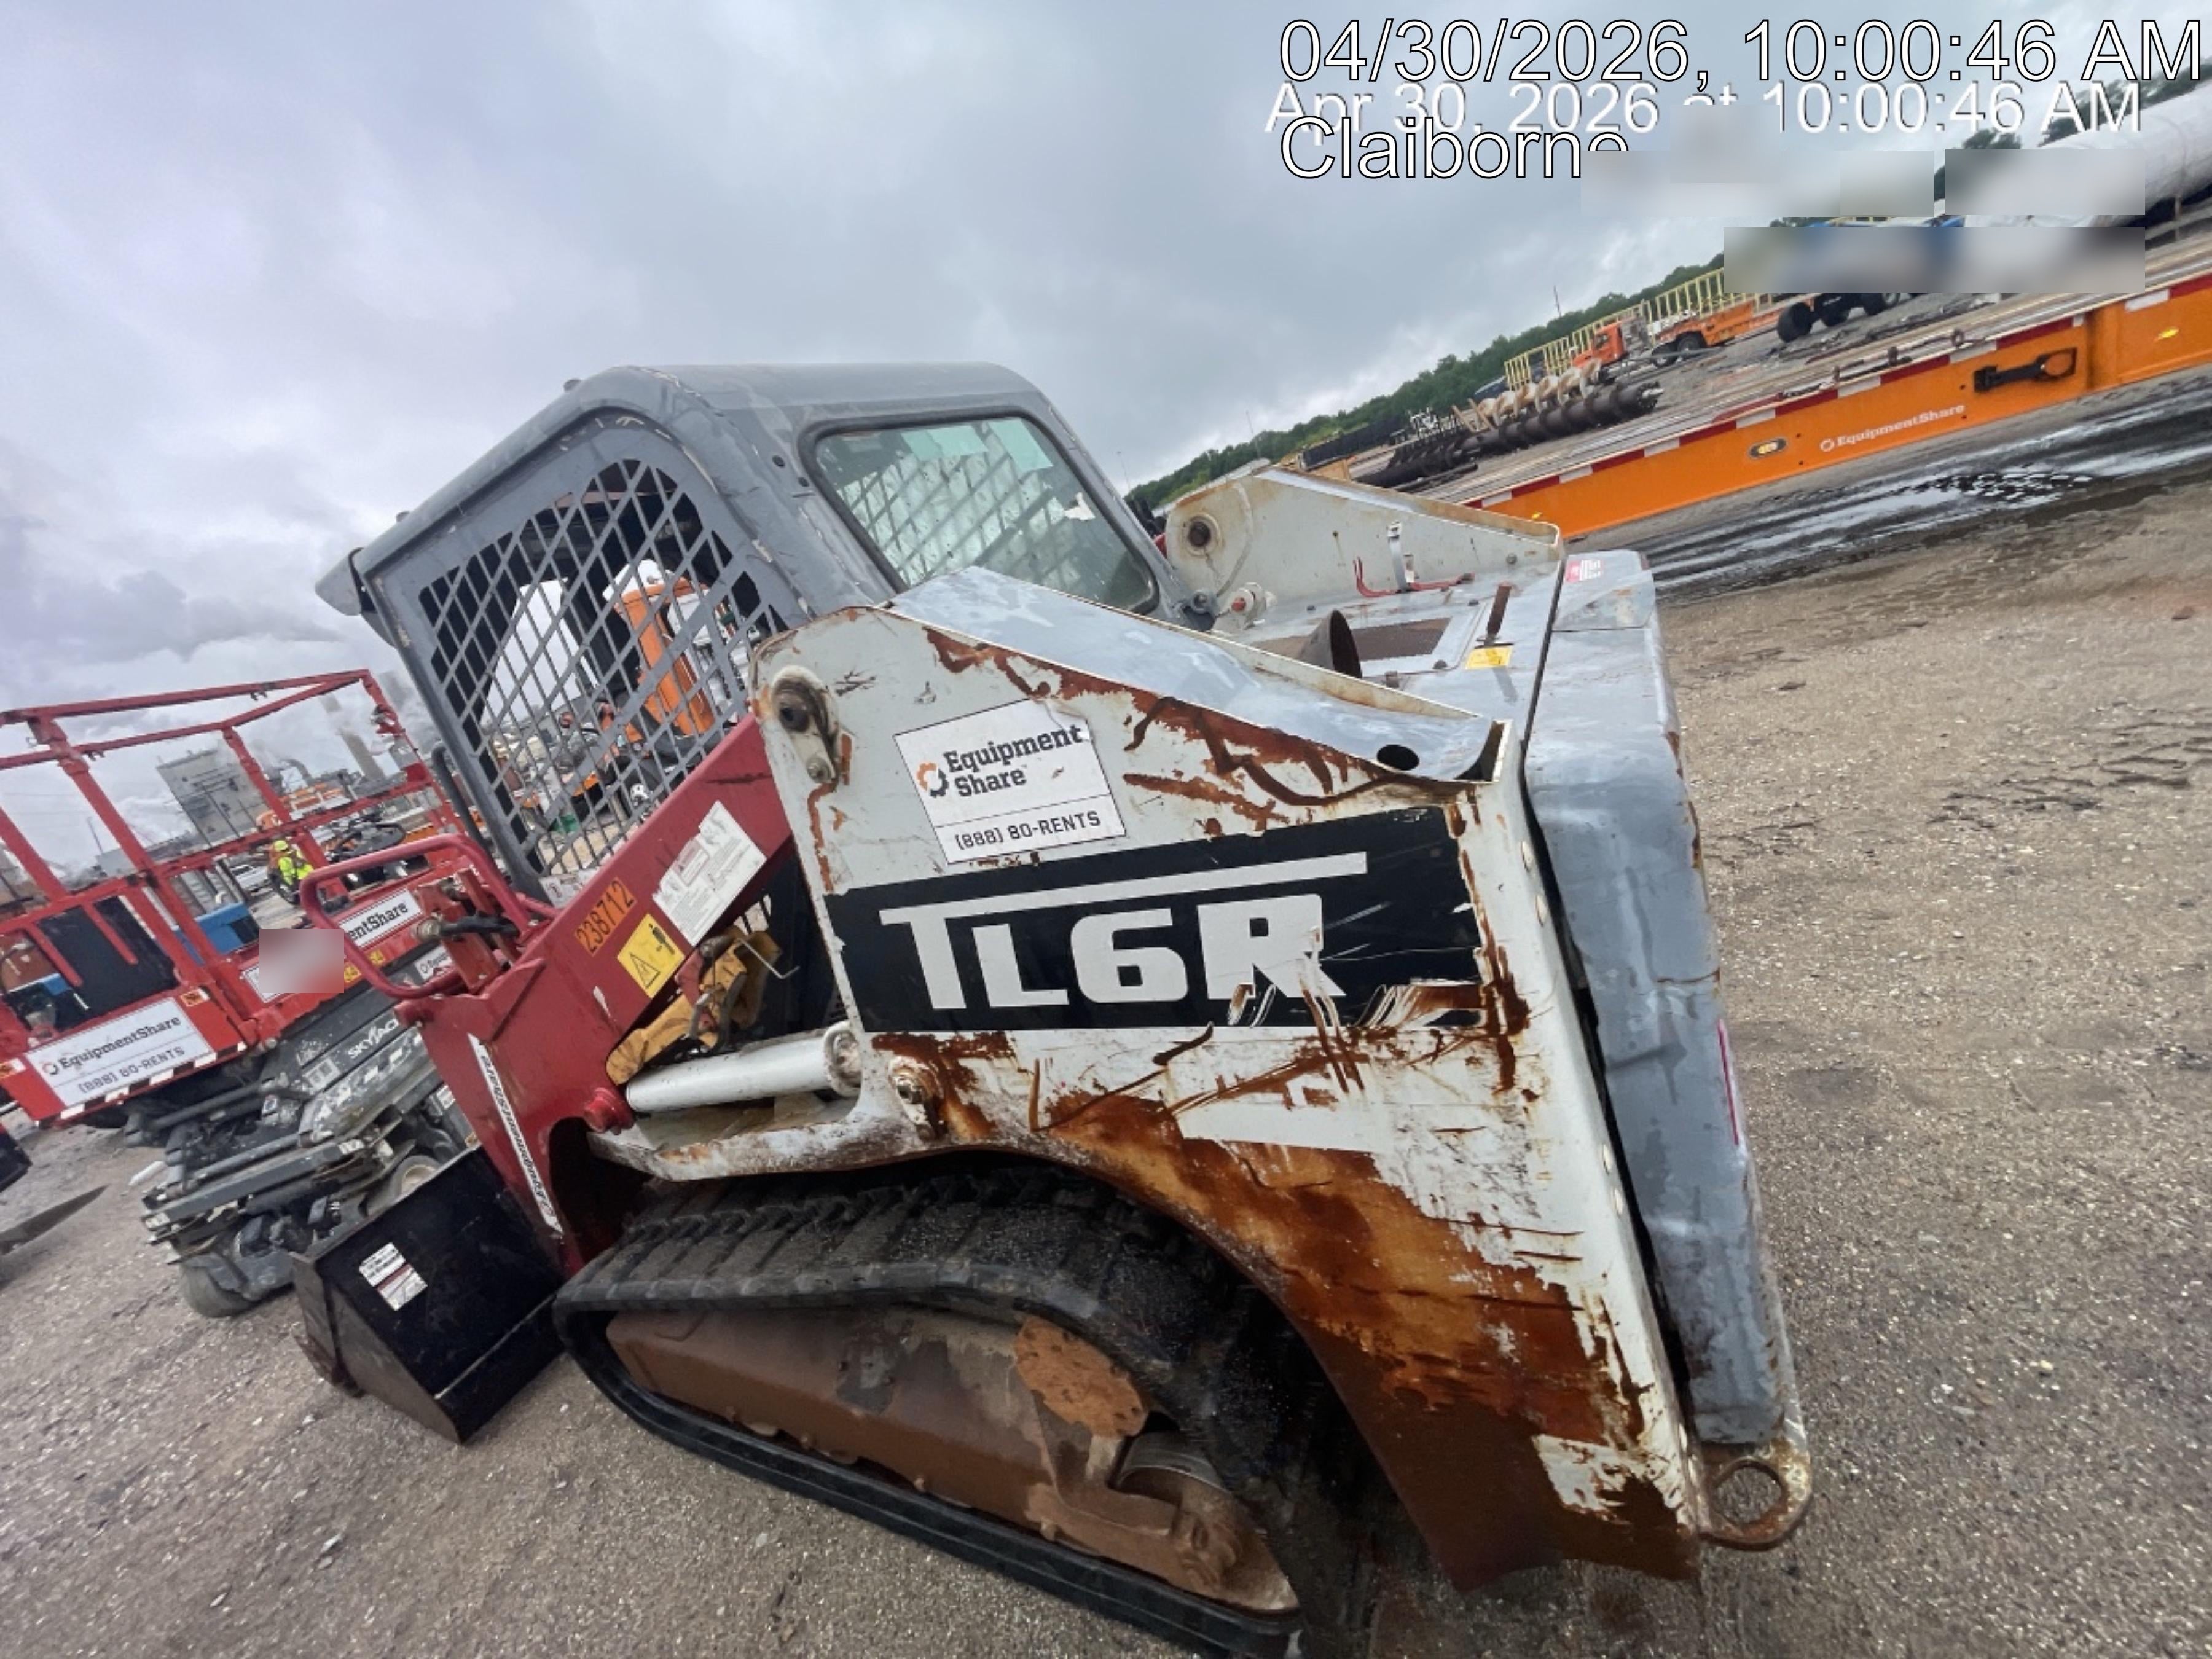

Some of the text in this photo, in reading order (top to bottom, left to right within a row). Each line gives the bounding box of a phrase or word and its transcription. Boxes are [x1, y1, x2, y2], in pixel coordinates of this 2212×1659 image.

[1837, 404, 1965, 446] EquipmentShare
[943, 724, 1084, 773] Equipment
[954, 768, 1027, 797] Share
[954, 810, 1101, 850] (888) 80-RENTS
[576, 880, 635, 953] 238712
[879, 852, 1367, 1010] TL6R
[59, 1016, 181, 1069] EquipmentShare
[348, 1018, 399, 1059] SKYJAC
[77, 1046, 185, 1094] (888) 80-RENTS
